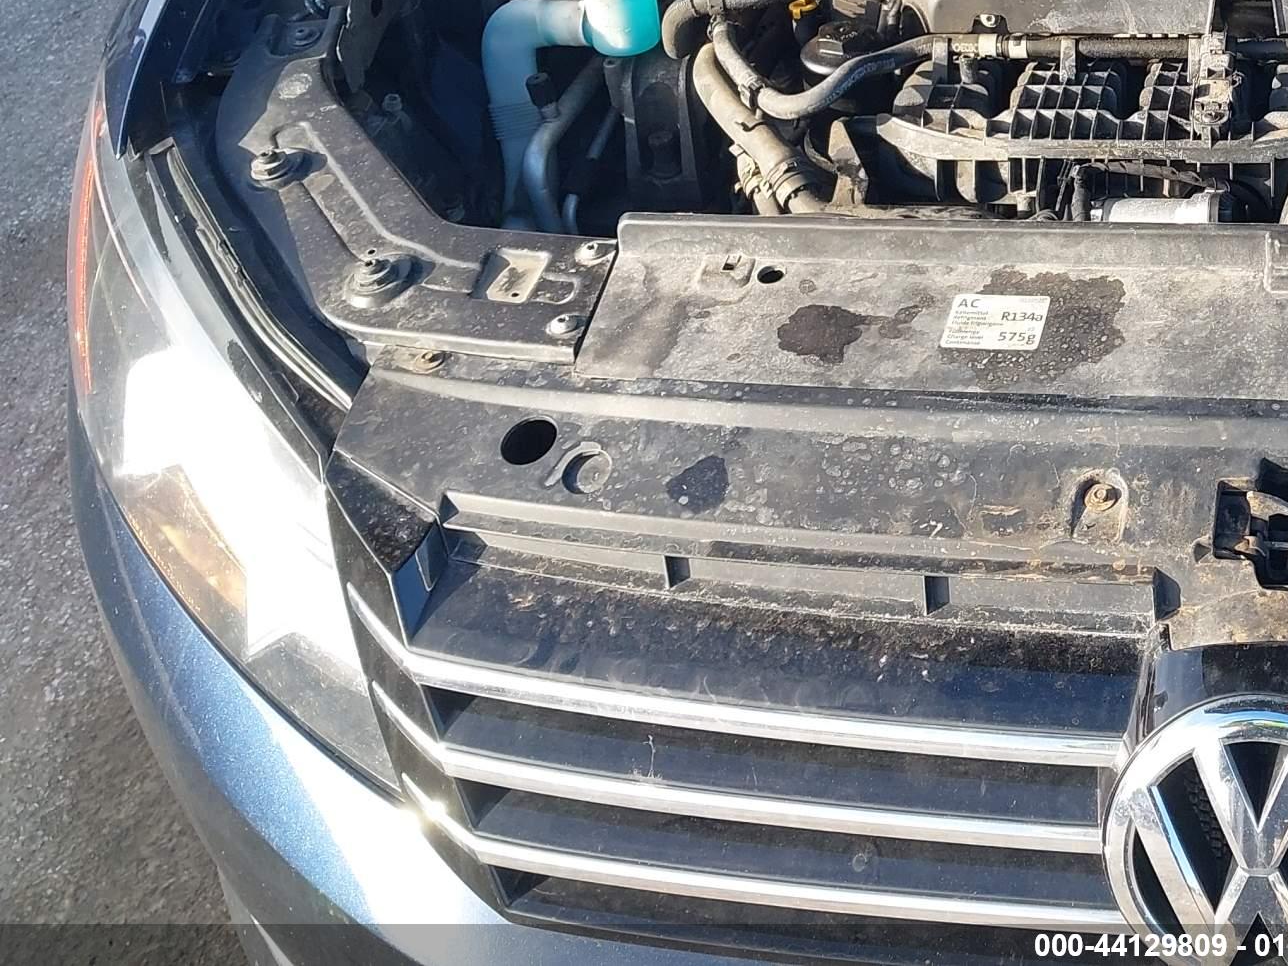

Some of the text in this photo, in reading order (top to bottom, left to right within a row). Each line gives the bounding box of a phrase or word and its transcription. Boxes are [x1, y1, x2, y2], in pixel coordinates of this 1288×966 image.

[957, 298, 981, 308] AC
[1000, 311, 1043, 322] R134a
[997, 331, 1036, 346] 575g
